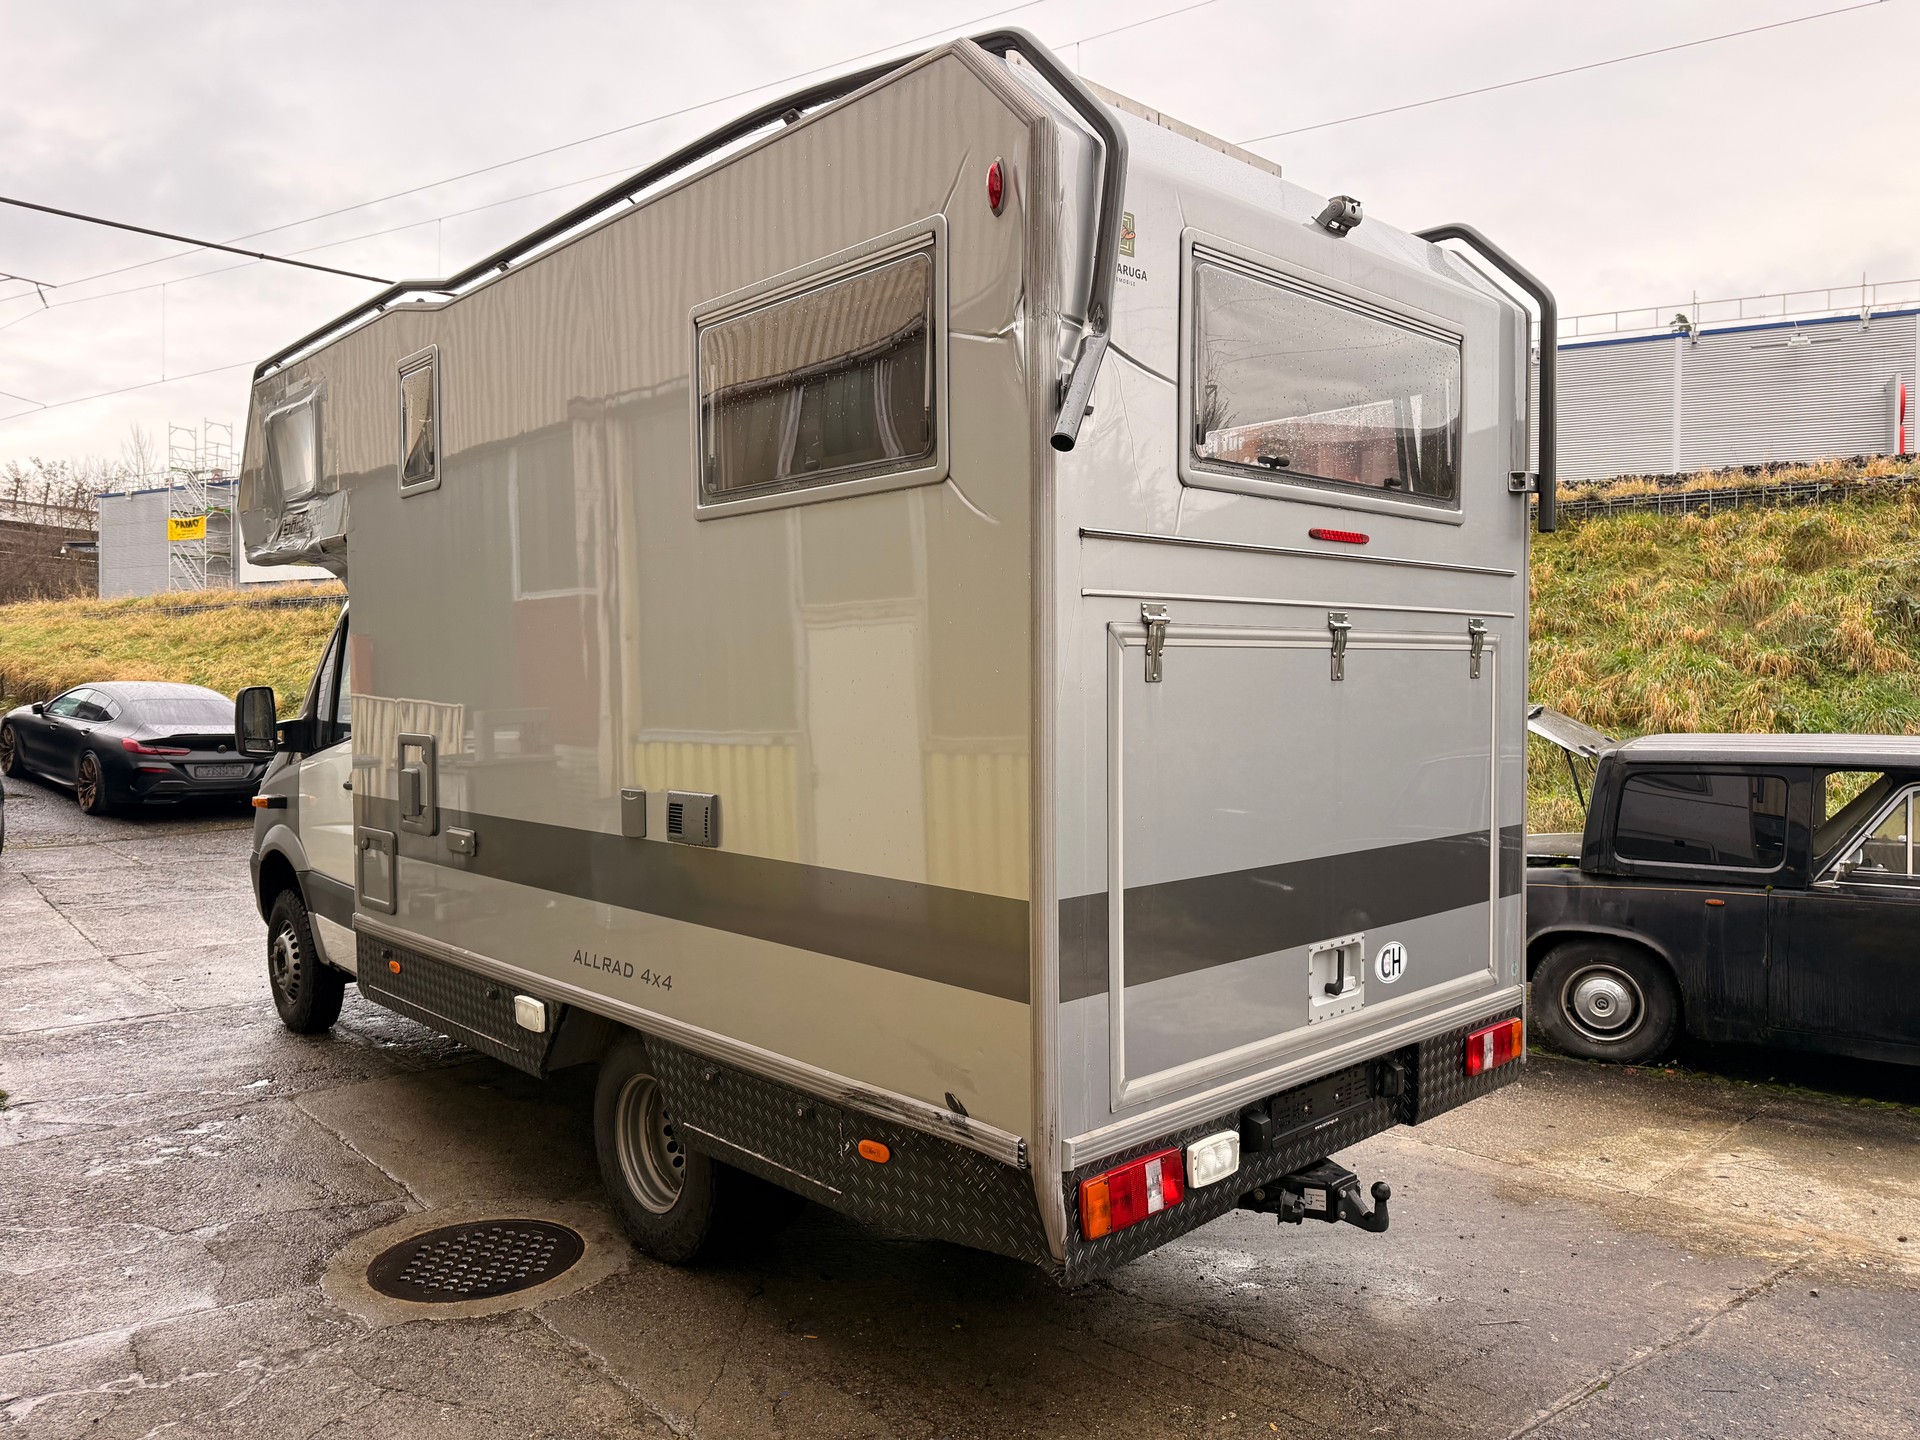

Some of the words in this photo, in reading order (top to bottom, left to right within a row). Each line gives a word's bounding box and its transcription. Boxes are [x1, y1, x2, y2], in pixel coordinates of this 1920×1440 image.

[175, 519, 199, 529] PAMO
[573, 949, 634, 979] ALLRAD
[640, 968, 673, 991] 4x4
[1381, 946, 1402, 979] CH
